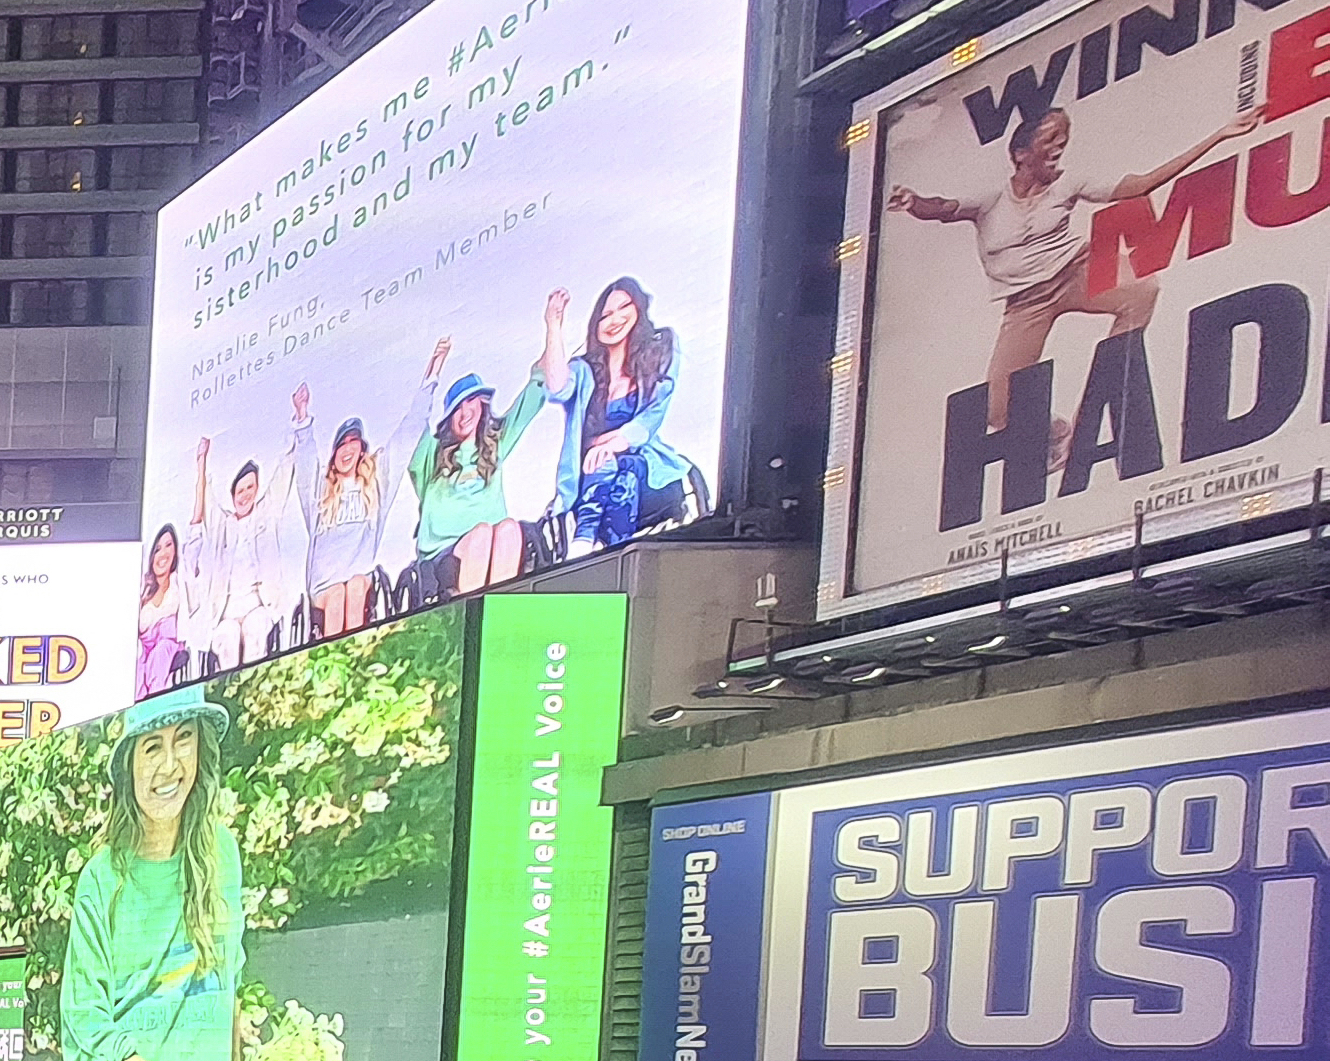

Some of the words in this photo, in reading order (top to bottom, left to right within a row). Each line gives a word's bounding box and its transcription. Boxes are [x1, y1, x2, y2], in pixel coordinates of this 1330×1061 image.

[1236, 39, 1261, 113] INCLUDING
[193, 266, 214, 291] is
[223, 238, 261, 273] my
[271, 149, 387, 249] passion
[401, 101, 452, 154] for
[467, 54, 524, 110] my
[274, 117, 369, 199] makes
[382, 73, 431, 124] me
[192, 213, 339, 330] sisterhood
[352, 167, 412, 229] and
[428, 132, 479, 181] my
[189, 347, 276, 409] Rollettes
[282, 306, 352, 357] Dance
[359, 267, 423, 309] Team
[434, 190, 552, 272] Member
[190, 328, 259, 382] Natalie
[940, 283, 1330, 533] HAD
[1202, 463, 1280, 499] CHAVKIN
[13, 573, 49, 585] WHO
[994, 521, 1064, 551] MITCHELL
[535, 641, 567, 738] Voice
[521, 750, 562, 959] #AerieREAL
[662, 825, 696, 841] SHOP
[697, 820, 747, 838] ONLINE
[833, 762, 1330, 902] SUPPOR
[12, 997, 24, 1008] Vo
[524, 972, 552, 1047] your
[823, 874, 1318, 1049] BUSI
